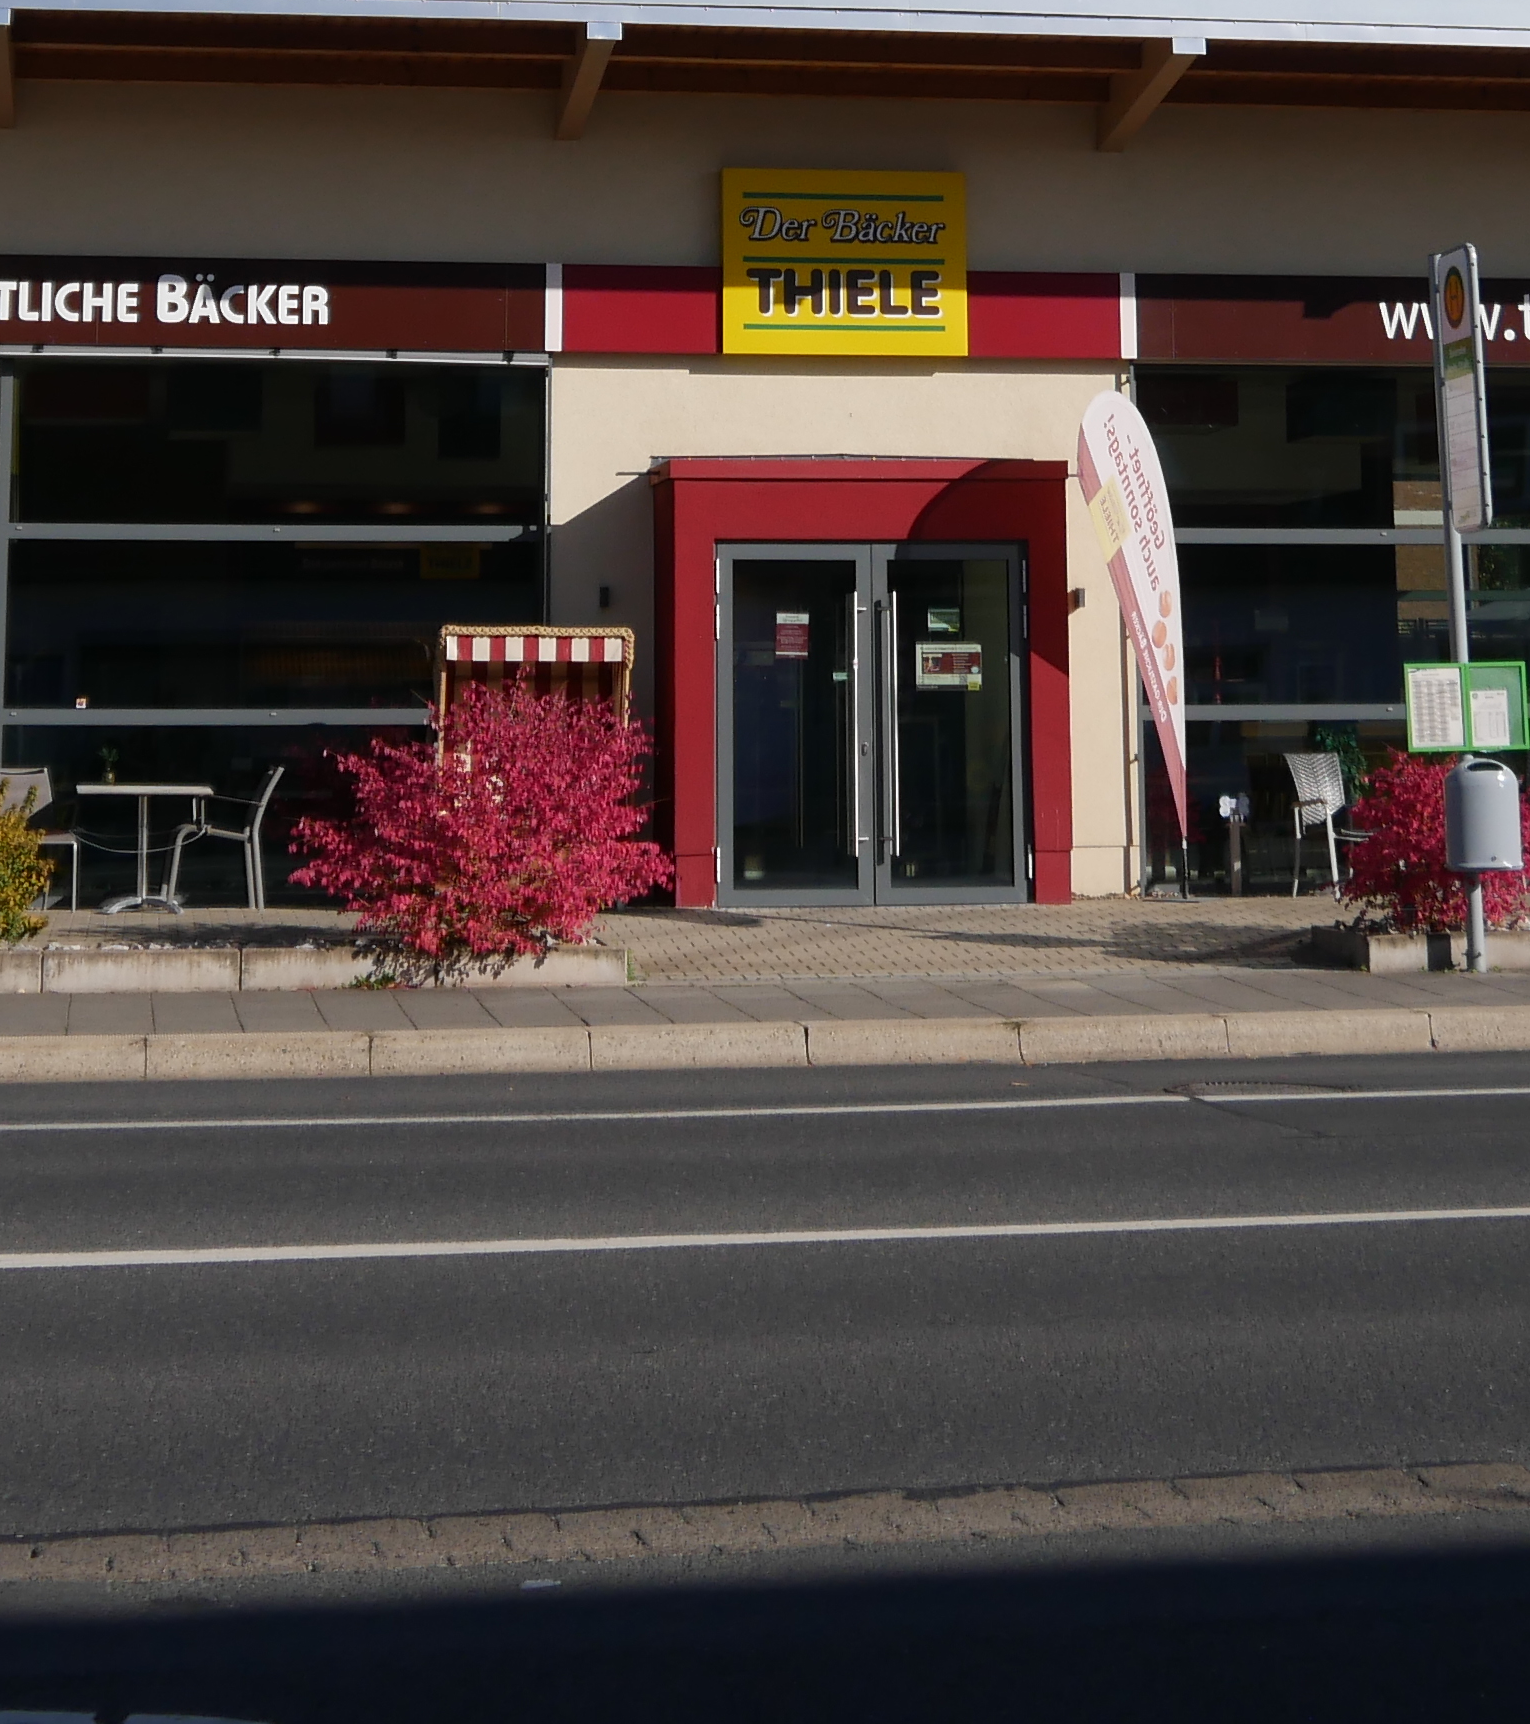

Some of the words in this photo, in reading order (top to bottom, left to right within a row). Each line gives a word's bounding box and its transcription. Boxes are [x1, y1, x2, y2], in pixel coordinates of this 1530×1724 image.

[739, 206, 815, 244] Der
[822, 208, 946, 245] Bäcker
[156, 273, 329, 325] BÄCKER
[746, 268, 943, 319] THIELE
